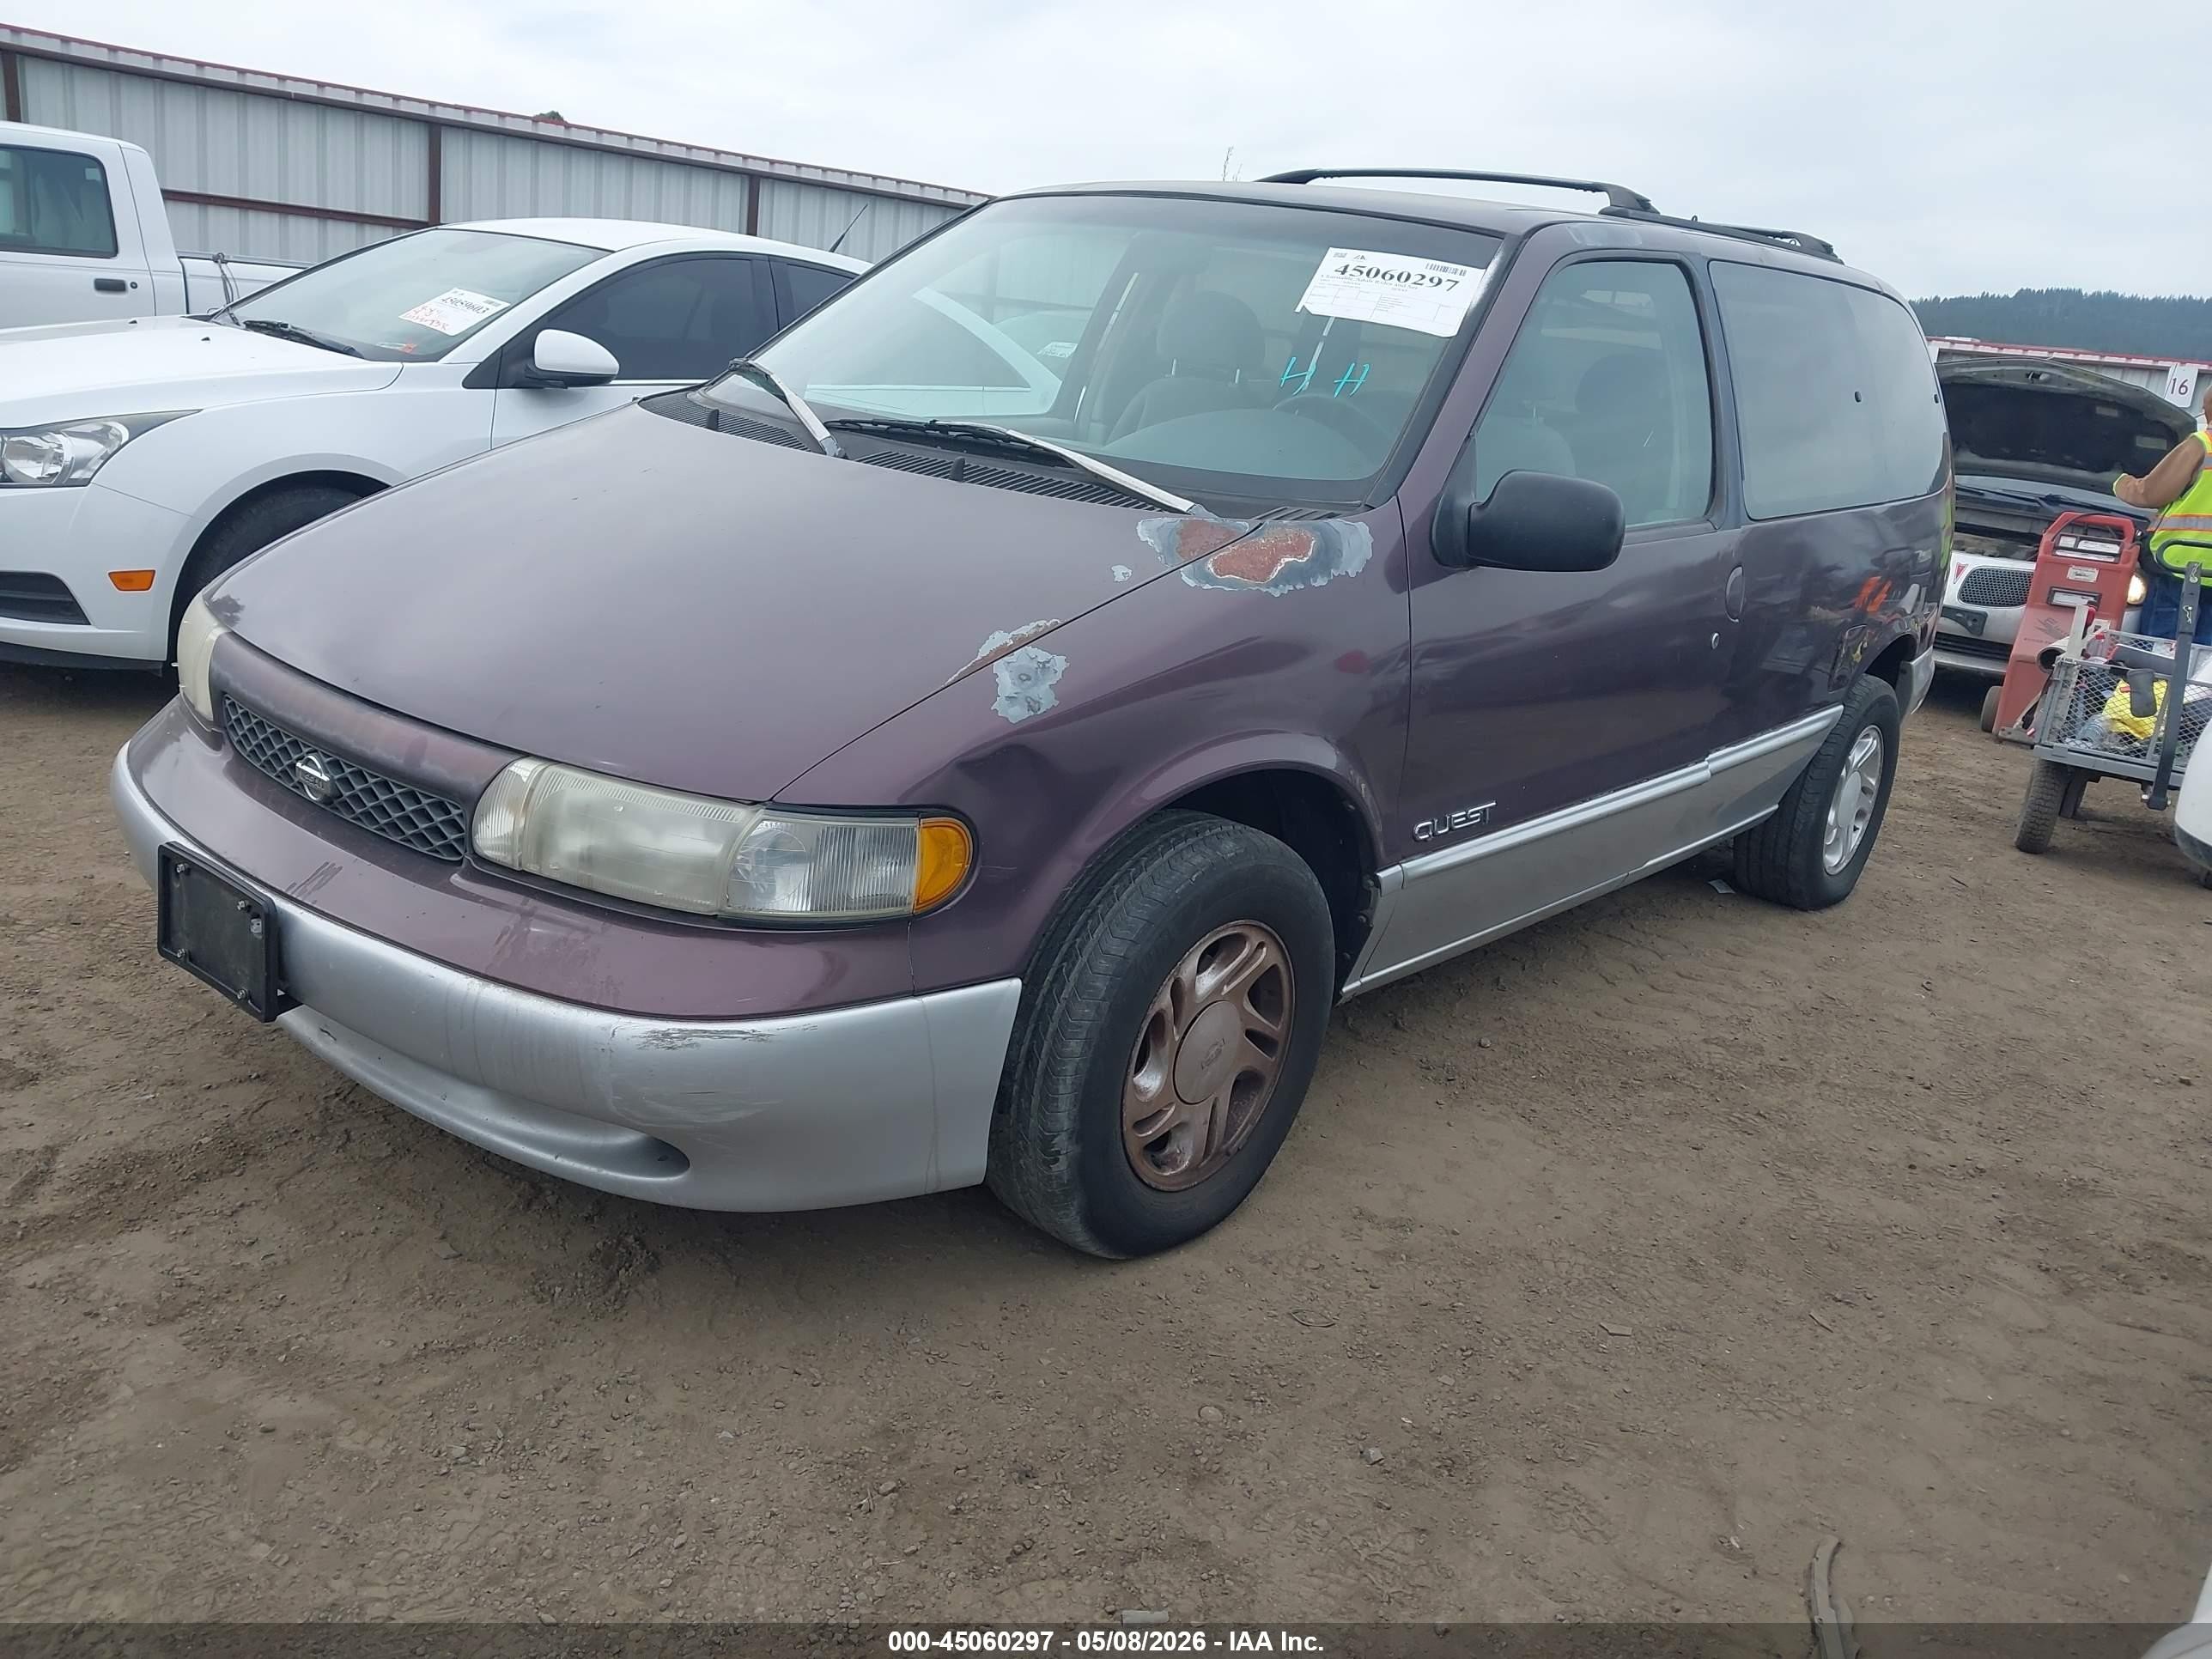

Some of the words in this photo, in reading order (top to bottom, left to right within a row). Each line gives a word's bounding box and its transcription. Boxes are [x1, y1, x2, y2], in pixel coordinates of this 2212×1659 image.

[1334, 264, 1460, 292] 45060297
[2171, 378, 2188, 395] 16
[1413, 800, 1497, 842] QUEST
